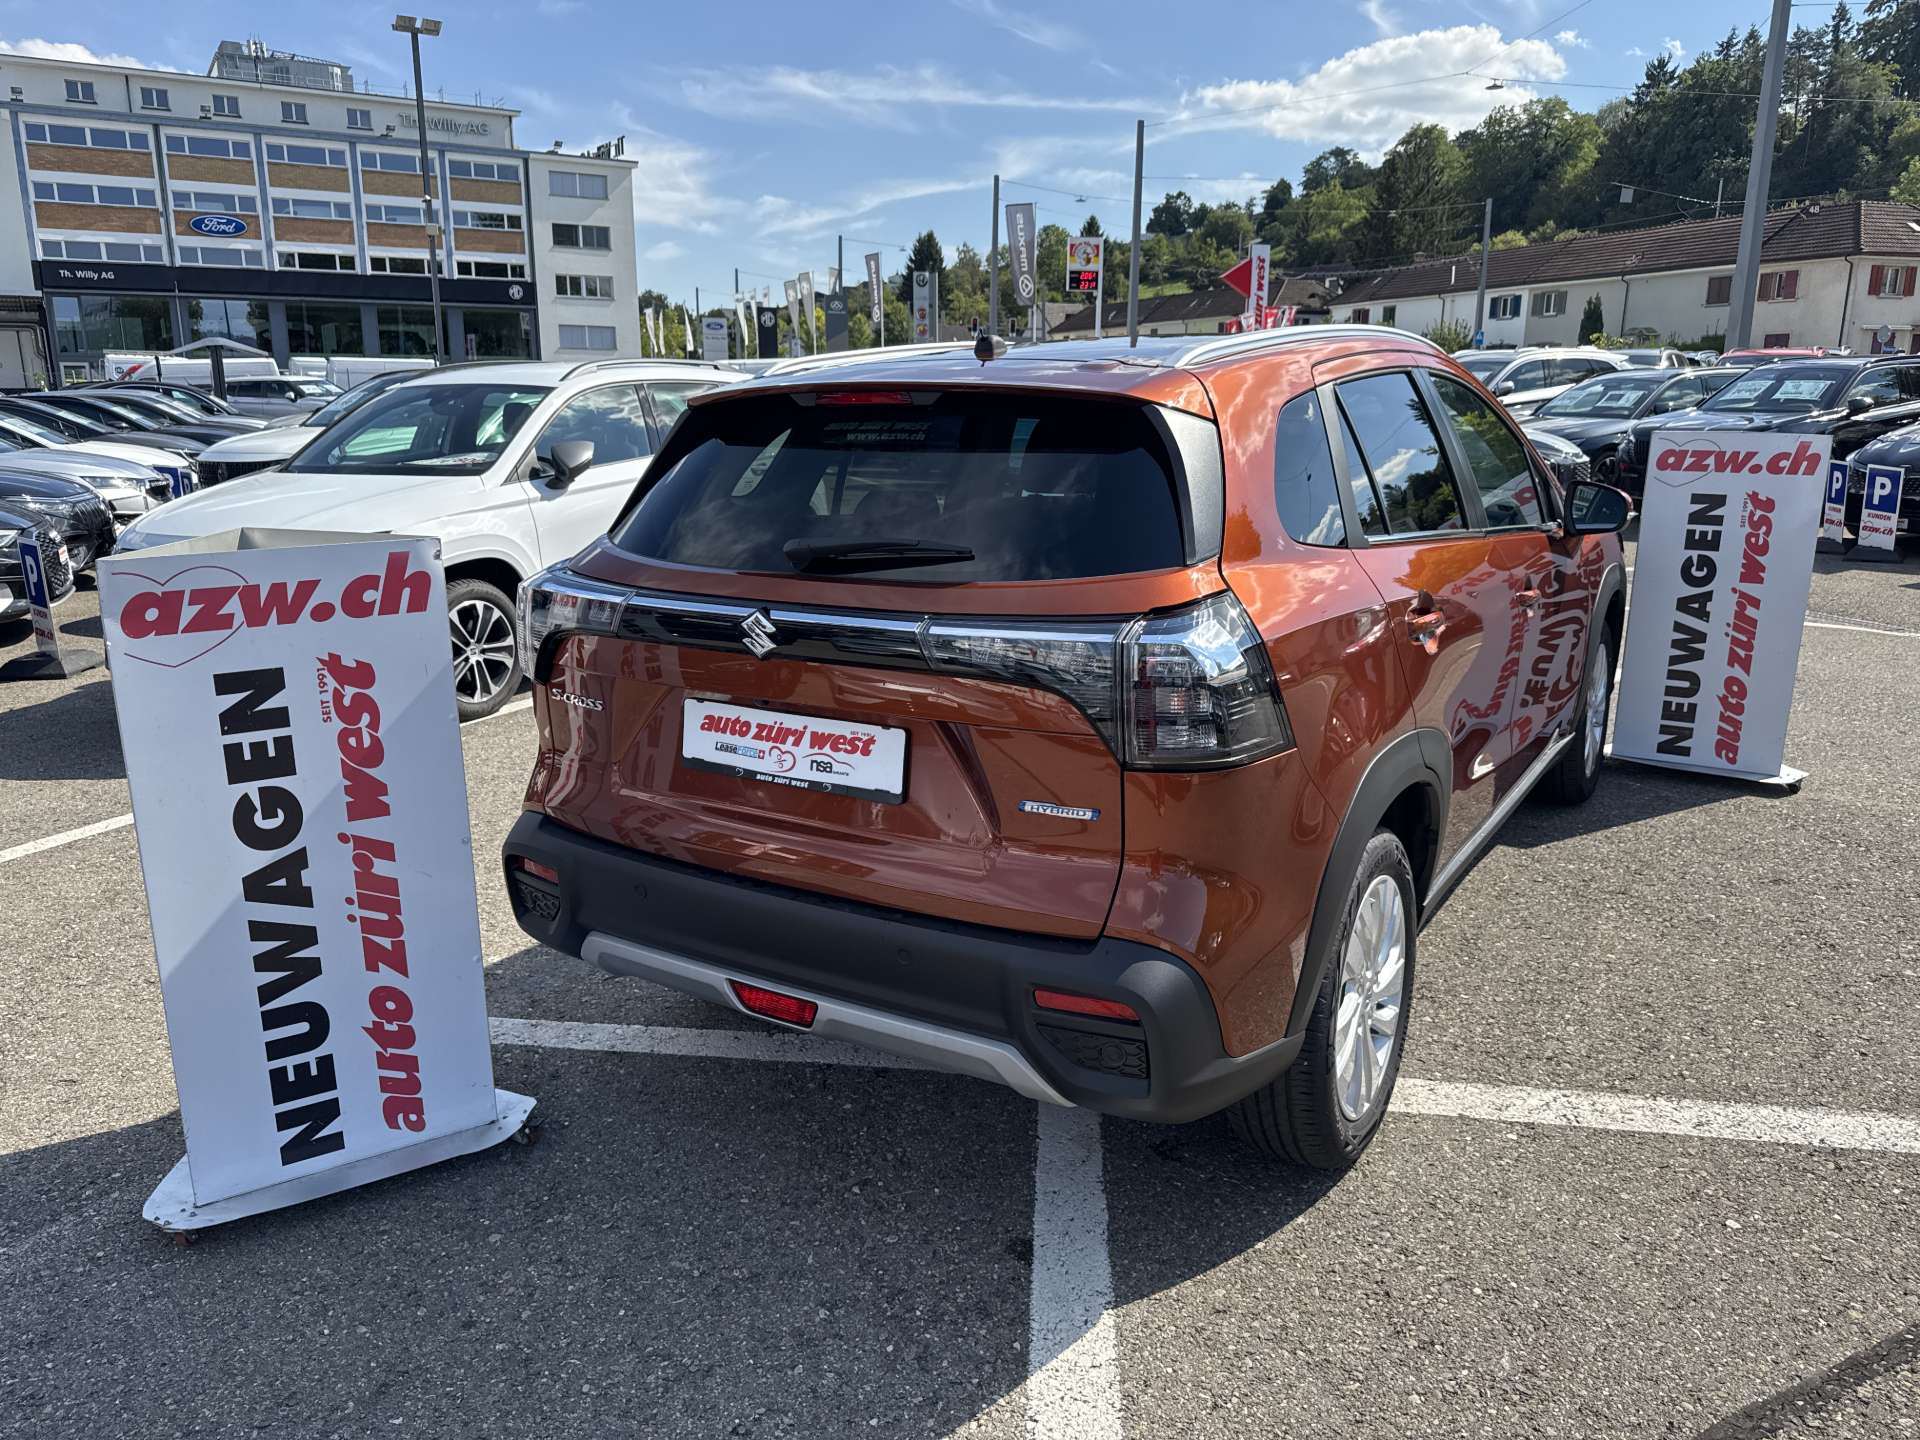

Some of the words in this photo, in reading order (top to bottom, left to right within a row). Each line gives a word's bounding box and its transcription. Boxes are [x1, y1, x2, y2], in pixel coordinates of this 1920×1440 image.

[429, 117, 463, 134] Willy
[464, 122, 489, 136] AG
[1808, 205, 1820, 213] 48
[201, 217, 236, 233] Ford
[59, 270, 74, 278] Th.
[75, 270, 98, 280] Willy
[101, 271, 115, 279] AG
[1656, 441, 1822, 476] azw.ch
[1831, 470, 1843, 498] P
[1872, 476, 1892, 505] P
[1861, 523, 1895, 537] azw.ch
[1867, 511, 1892, 521] KUNDEN
[1735, 490, 1776, 586] west
[25, 555, 38, 596] P
[119, 551, 432, 640] azw.ch
[1656, 493, 1727, 757] NEUWAGEN
[1725, 587, 1761, 674] züri
[317, 667, 329, 695] 1991
[320, 699, 332, 723] SEIT
[1714, 675, 1746, 764] auto
[315, 652, 391, 823] west
[700, 714, 751, 738] auto
[751, 720, 808, 748] züri
[809, 731, 877, 757] west
[756, 773, 773, 781] auto
[790, 780, 809, 788] west
[810, 760, 833, 773] nsa
[1030, 804, 1088, 817] HYBRID
[213, 667, 345, 1167] NEUWAGEN
[345, 832, 410, 980] züri
[361, 985, 426, 1133] auto
